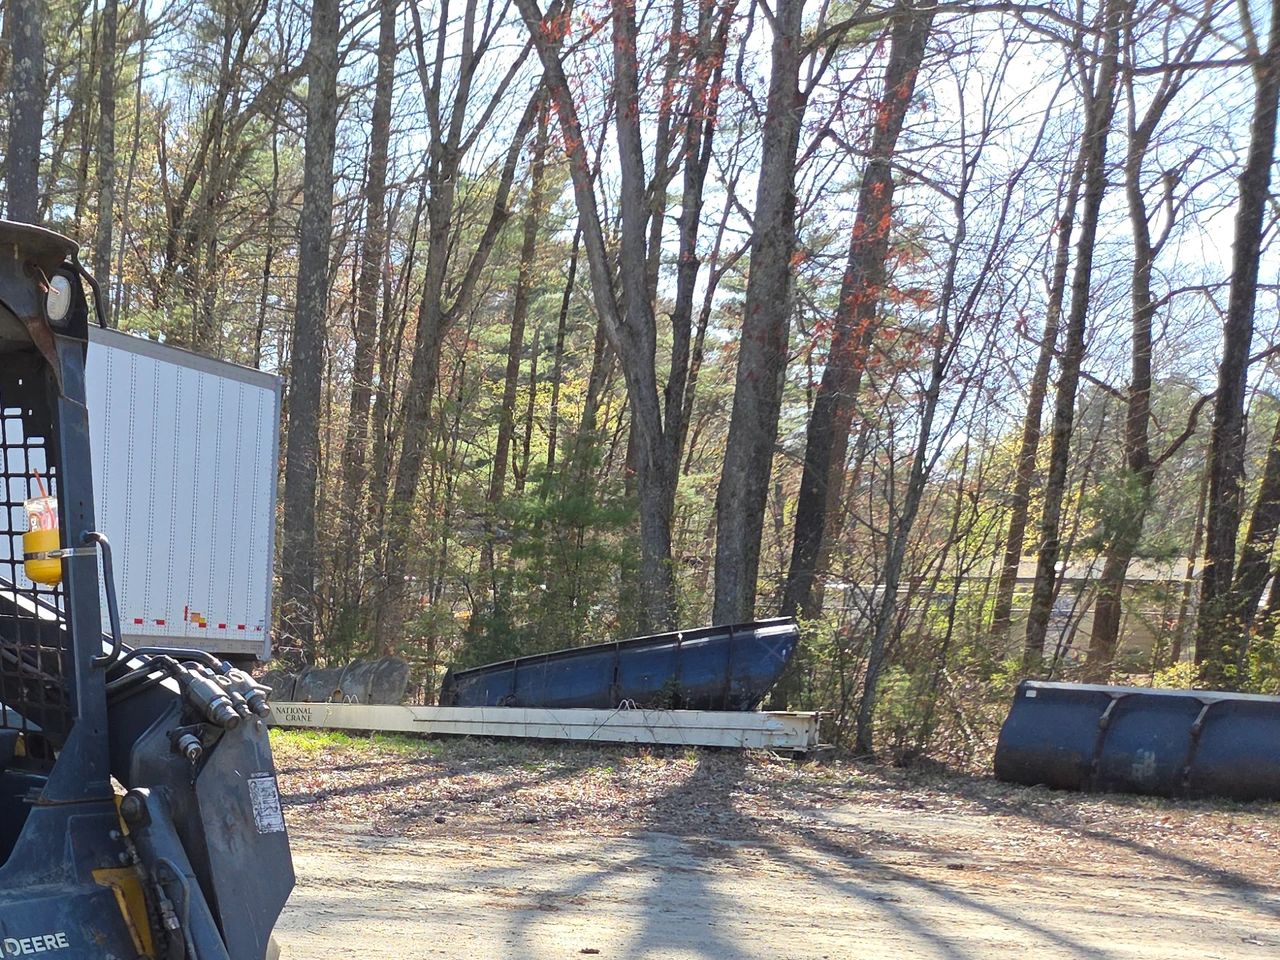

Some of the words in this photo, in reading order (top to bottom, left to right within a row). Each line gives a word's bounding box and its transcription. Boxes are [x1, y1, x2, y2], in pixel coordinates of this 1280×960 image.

[276, 706, 313, 715] NATIONAL
[285, 714, 313, 722] CRANE
[3, 931, 70, 957] DEERE
